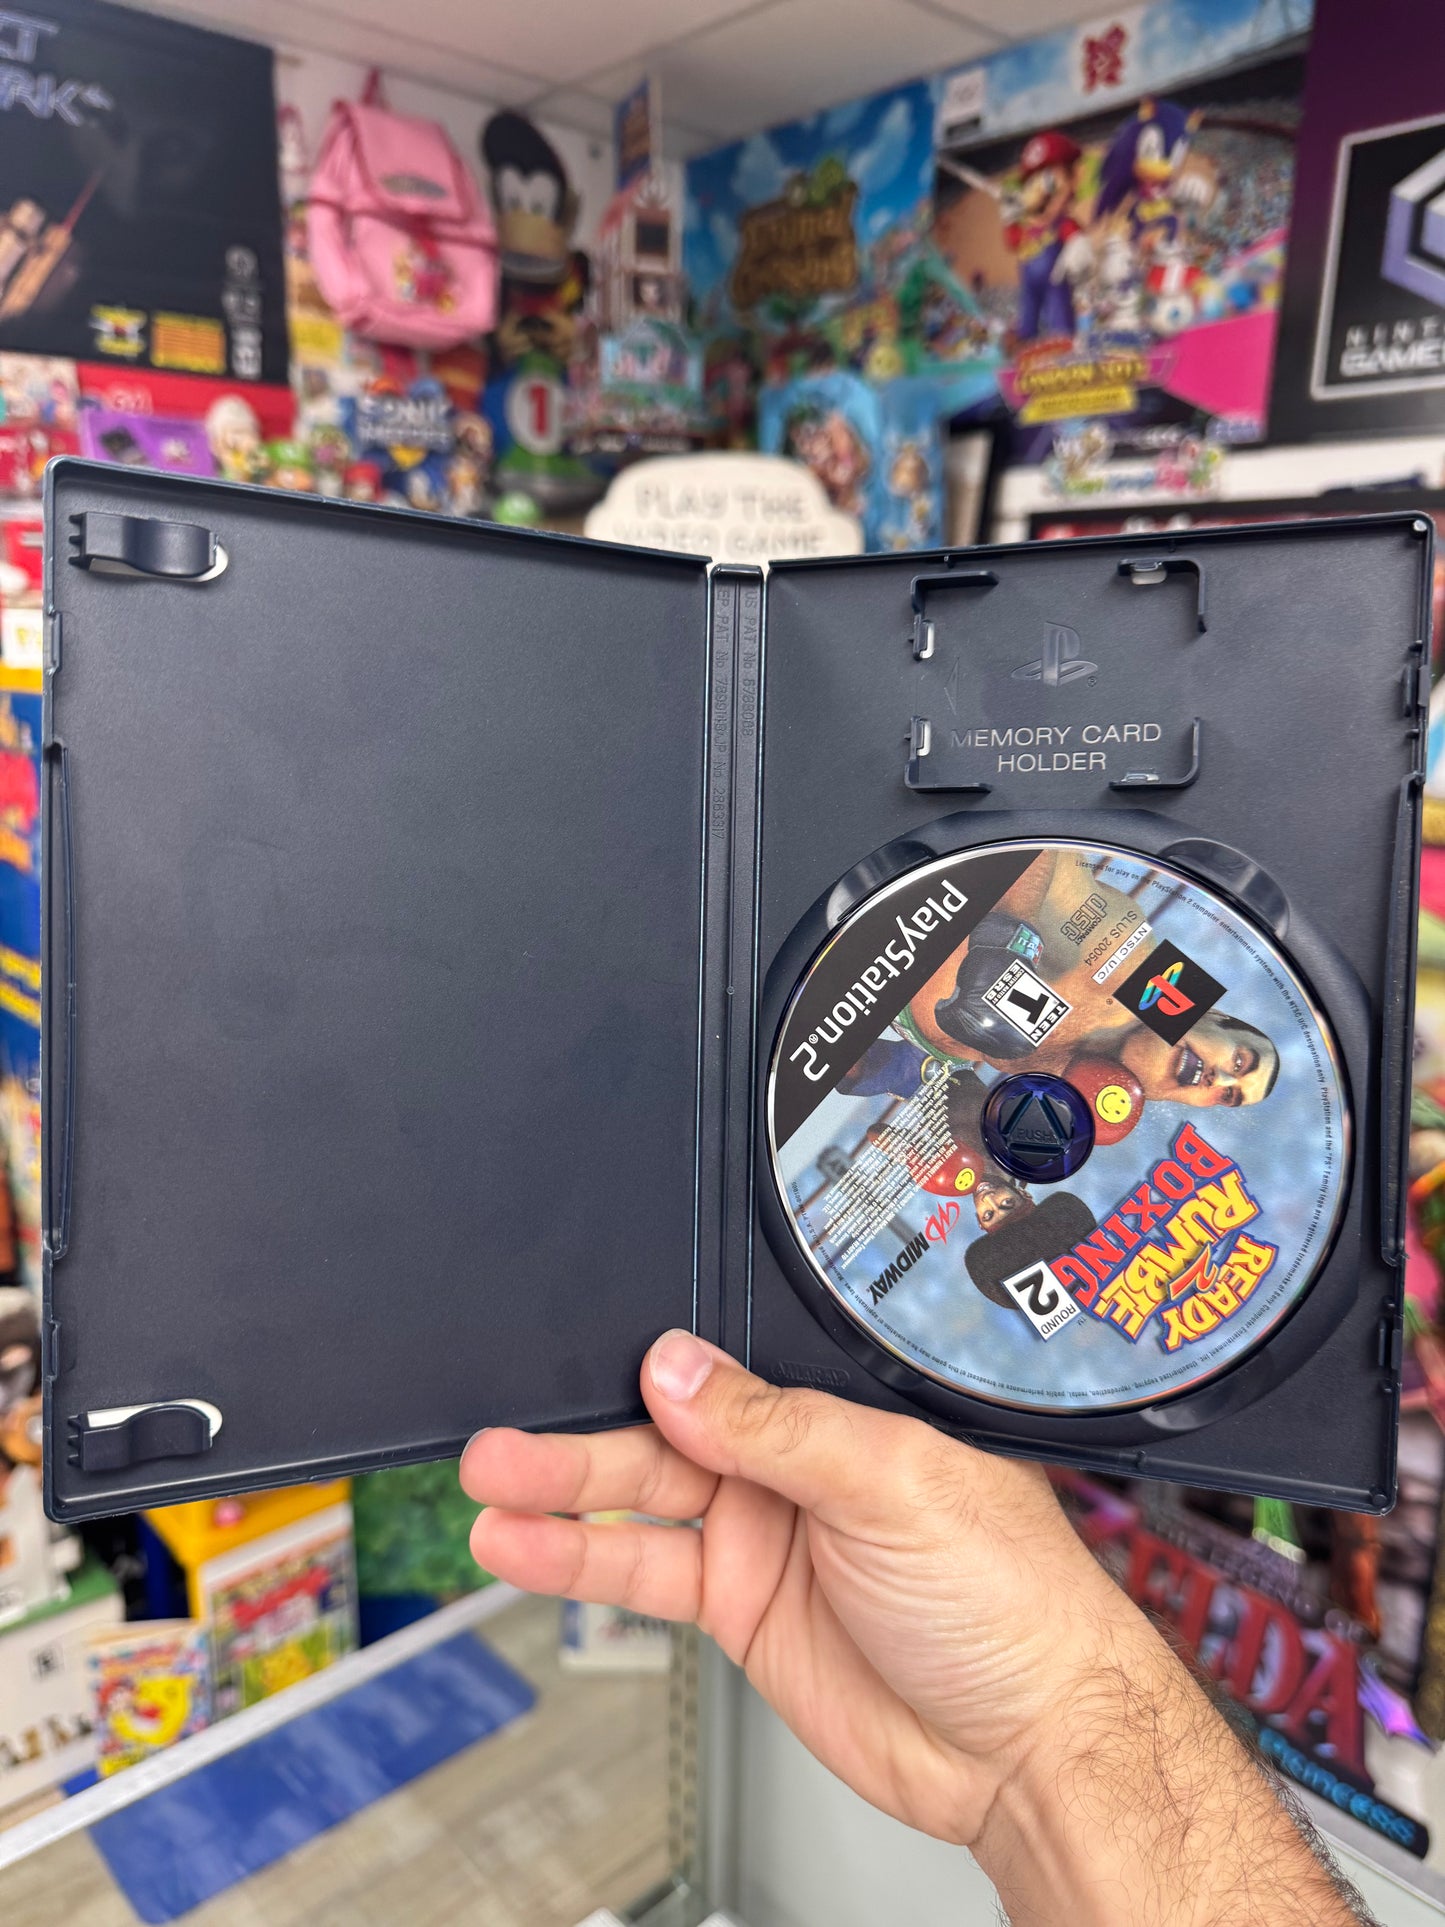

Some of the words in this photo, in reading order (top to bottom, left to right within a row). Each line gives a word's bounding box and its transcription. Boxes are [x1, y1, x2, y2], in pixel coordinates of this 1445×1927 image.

[1340, 337, 1445, 377] GAME
[950, 725, 1073, 749] MEMORY
[1081, 722, 1163, 745] CARD
[997, 751, 1107, 773] HOLDER
[1109, 910, 1138, 940] SLUS
[1083, 936, 1113, 967] 20054
[986, 964, 1021, 1002] ESRB
[1006, 988, 1050, 1026] T
[1030, 1005, 1067, 1041] TEEN
[1050, 1121, 1232, 1307] BOXING
[871, 1231, 931, 1306] MIDWAY
[1097, 1169, 1260, 1339] RUMBLE
[1014, 1269, 1060, 1316] 2
[1162, 1234, 1276, 1352] READY
[1040, 1303, 1077, 1336] ROUND
